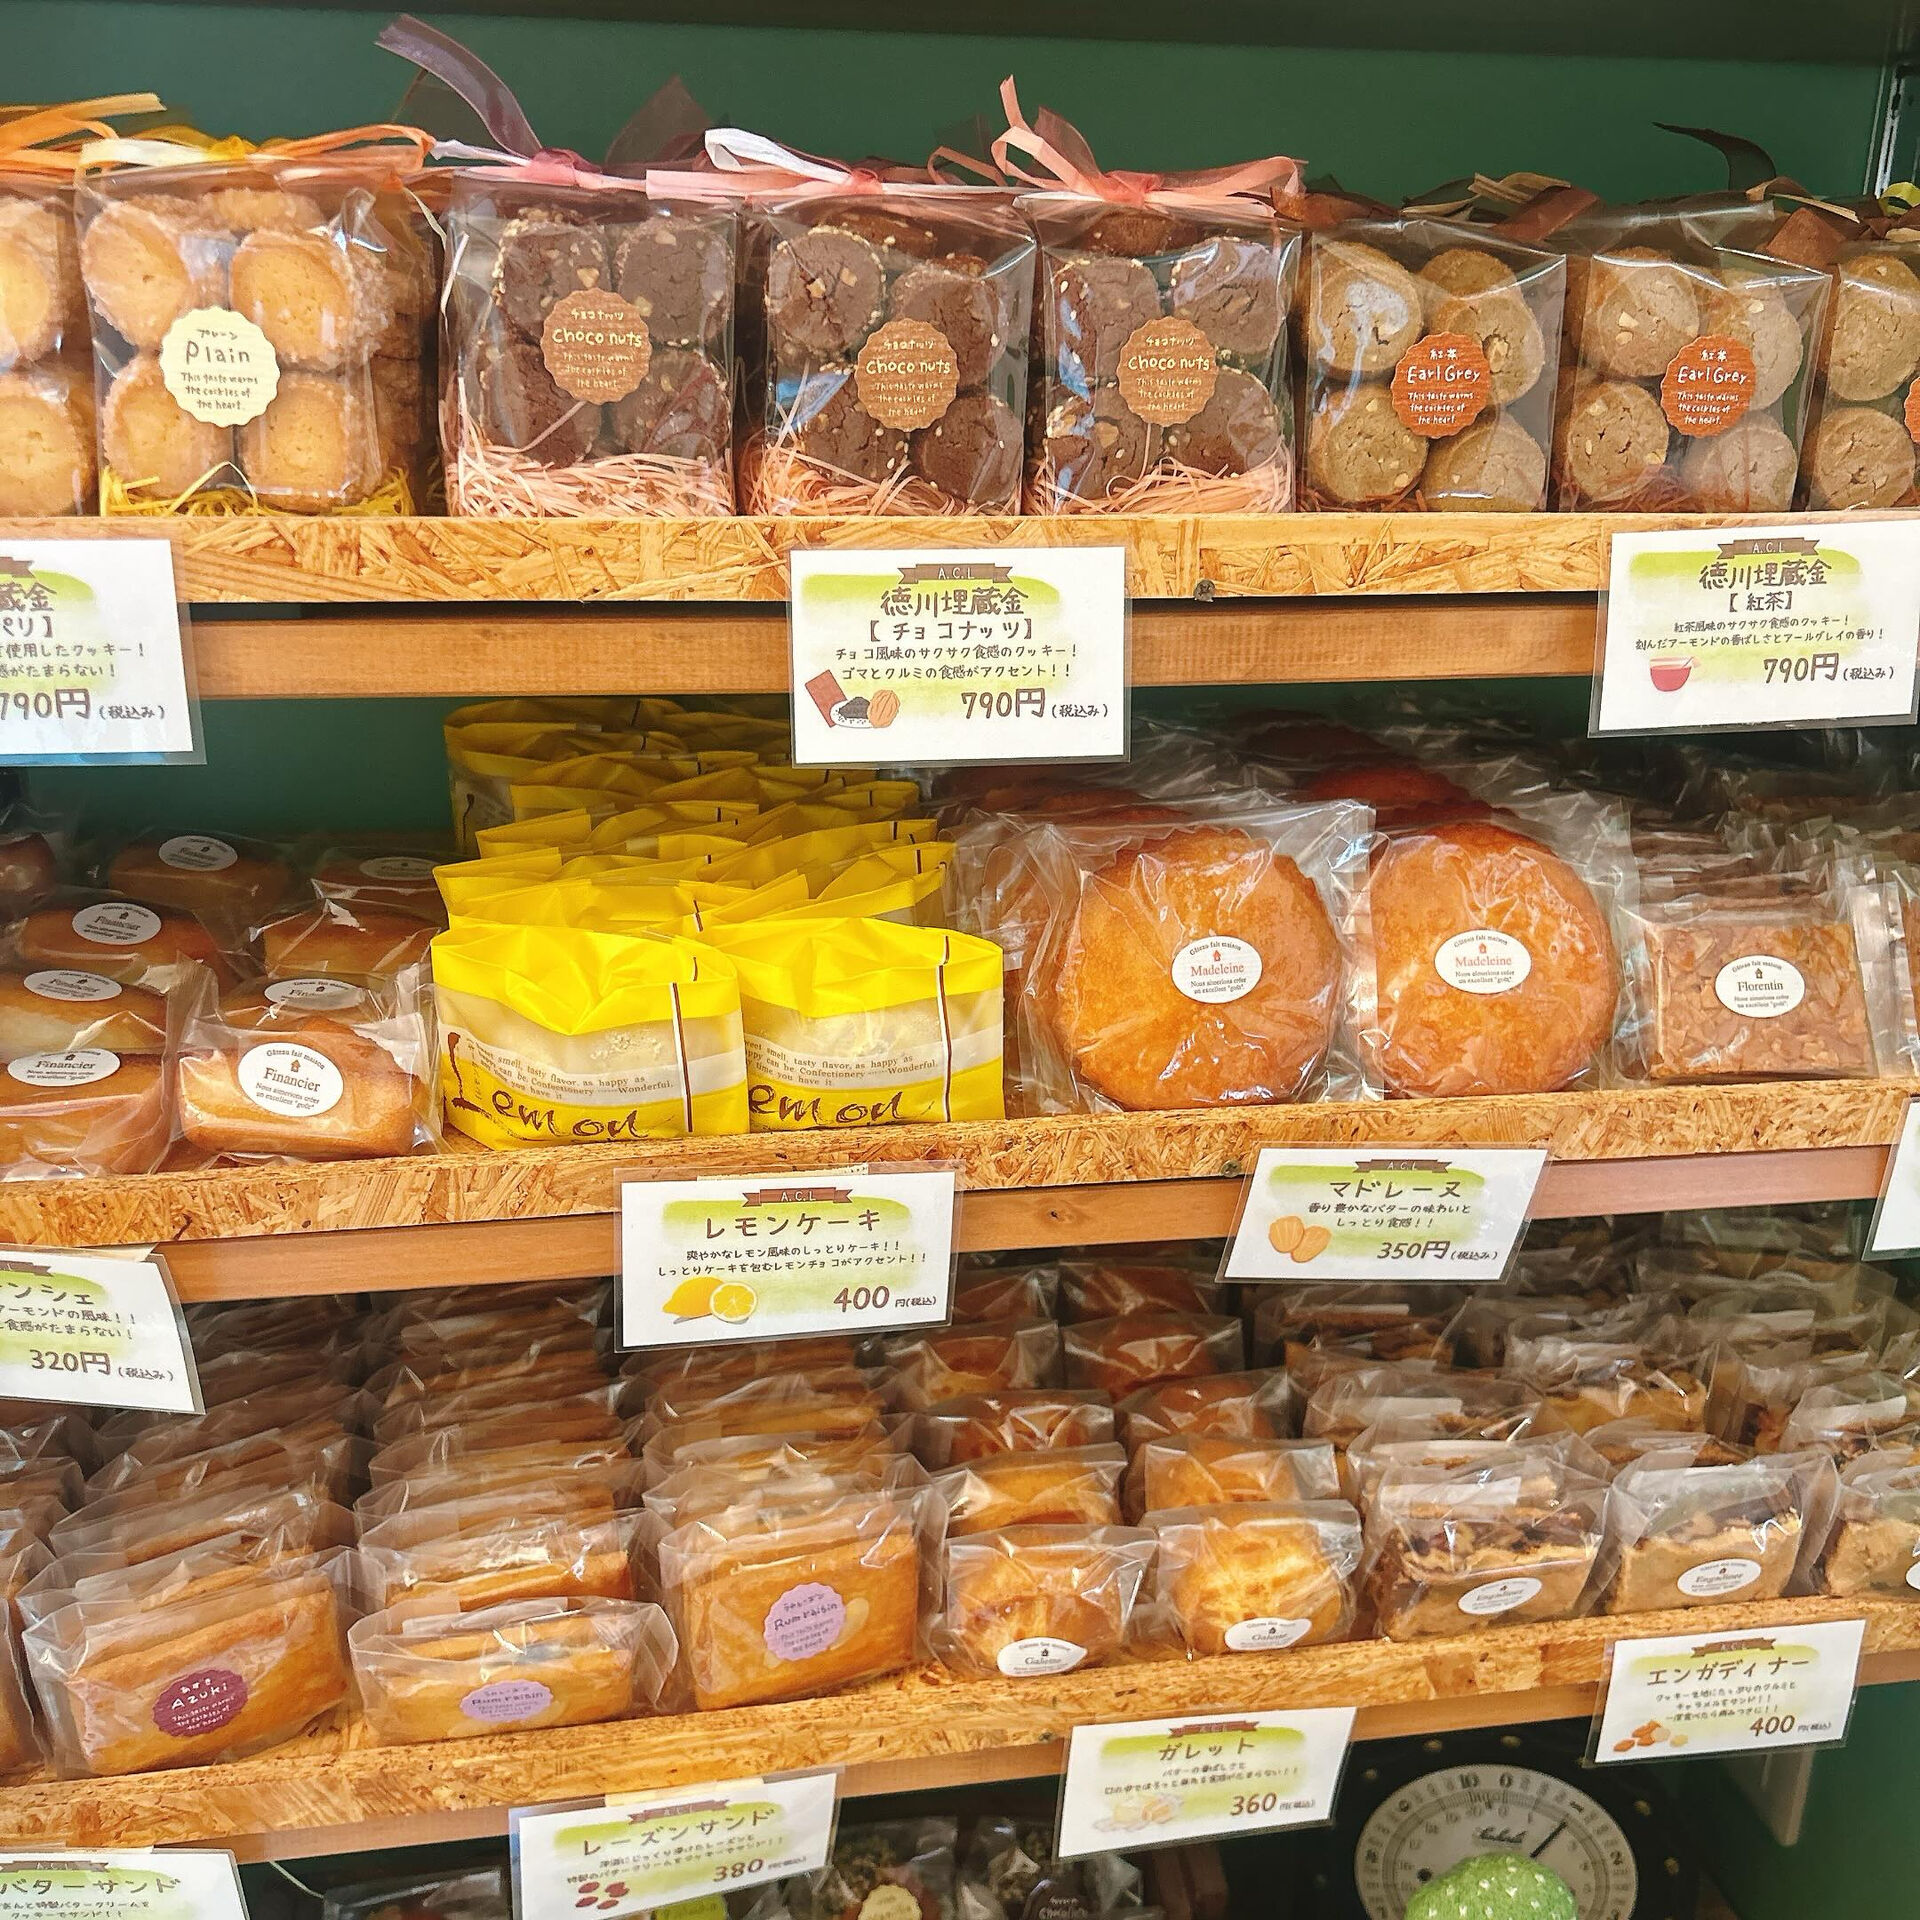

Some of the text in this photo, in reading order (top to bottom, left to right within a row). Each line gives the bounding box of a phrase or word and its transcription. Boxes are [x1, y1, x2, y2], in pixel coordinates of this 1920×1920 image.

[552, 328, 642, 347] Choco nuts
[186, 341, 249, 364] Plain
[1128, 355, 1210, 370] Choco nuts
[866, 358, 951, 374] Choco nuts
[1407, 365, 1480, 383] Earl Grey
[1678, 366, 1746, 384] Earl Grey
[1753, 541, 1785, 554] A.C.L
[938, 567, 975, 579] A.C.L
[1699, 559, 1832, 590] 徳川埋蔵金
[881, 587, 1028, 617] 徳川埋蔵金
[1729, 591, 1792, 613] 【紅茶】
[870, 618, 1032, 642] 【チョコナッツ】
[1674, 615, 1850, 633] 紅茶風味のサクサク食感のクッキー！
[1636, 629, 1884, 650] 刻んだアーモンドの香ばしさとアールグレイの香り！
[0, 643, 144, 658] 使用したクッキー！
[836, 644, 1077, 660] チョコ風味のサクサク食感のクッキー！
[843, 664, 1070, 680] ゴマとクルミの食感がアクセント！！
[1764, 653, 1839, 684] 790円
[0, 689, 90, 720] 790円
[961, 688, 1045, 719] 790円
[1191, 963, 1244, 976] Madeleine
[1456, 956, 1512, 967] Madeleine
[1737, 981, 1783, 991] Florentin
[767, 1058, 779, 1067] can
[800, 1068, 865, 1078] Confectionery
[795, 1059, 816, 1067] tasty
[871, 1057, 897, 1069] happy
[264, 1067, 320, 1092] Financier
[599, 1077, 629, 1088] happy
[799, 1076, 819, 1084] have
[781, 1190, 816, 1201] A.C.L
[1330, 1179, 1461, 1199] マドレーヌ
[1308, 1202, 1471, 1214] 香り豊かなバターの味わいと
[706, 1209, 880, 1239] レモンケーキ
[1337, 1216, 1434, 1228] しっとり食感！！
[687, 1241, 900, 1260] 爽やかなレモン風味のしっとりケーキ！！
[1377, 1240, 1450, 1259] 350円
[659, 1253, 927, 1276] しっとりケーキを包むレモンチョコがアクセント！！
[0, 1283, 94, 1305] ンシェ
[834, 1286, 889, 1312] 400
[0, 1319, 132, 1339] 食感がたまらない！
[30, 1350, 110, 1375] 320円
[1647, 1656, 1809, 1686] エンガディナー
[172, 1682, 227, 1710] Azuki
[1750, 1715, 1795, 1737] 400
[1159, 1737, 1255, 1761] ガレット
[1230, 1792, 1276, 1816] 360
[584, 1809, 774, 1856] レーズンサンド
[713, 1859, 764, 1882] 380
